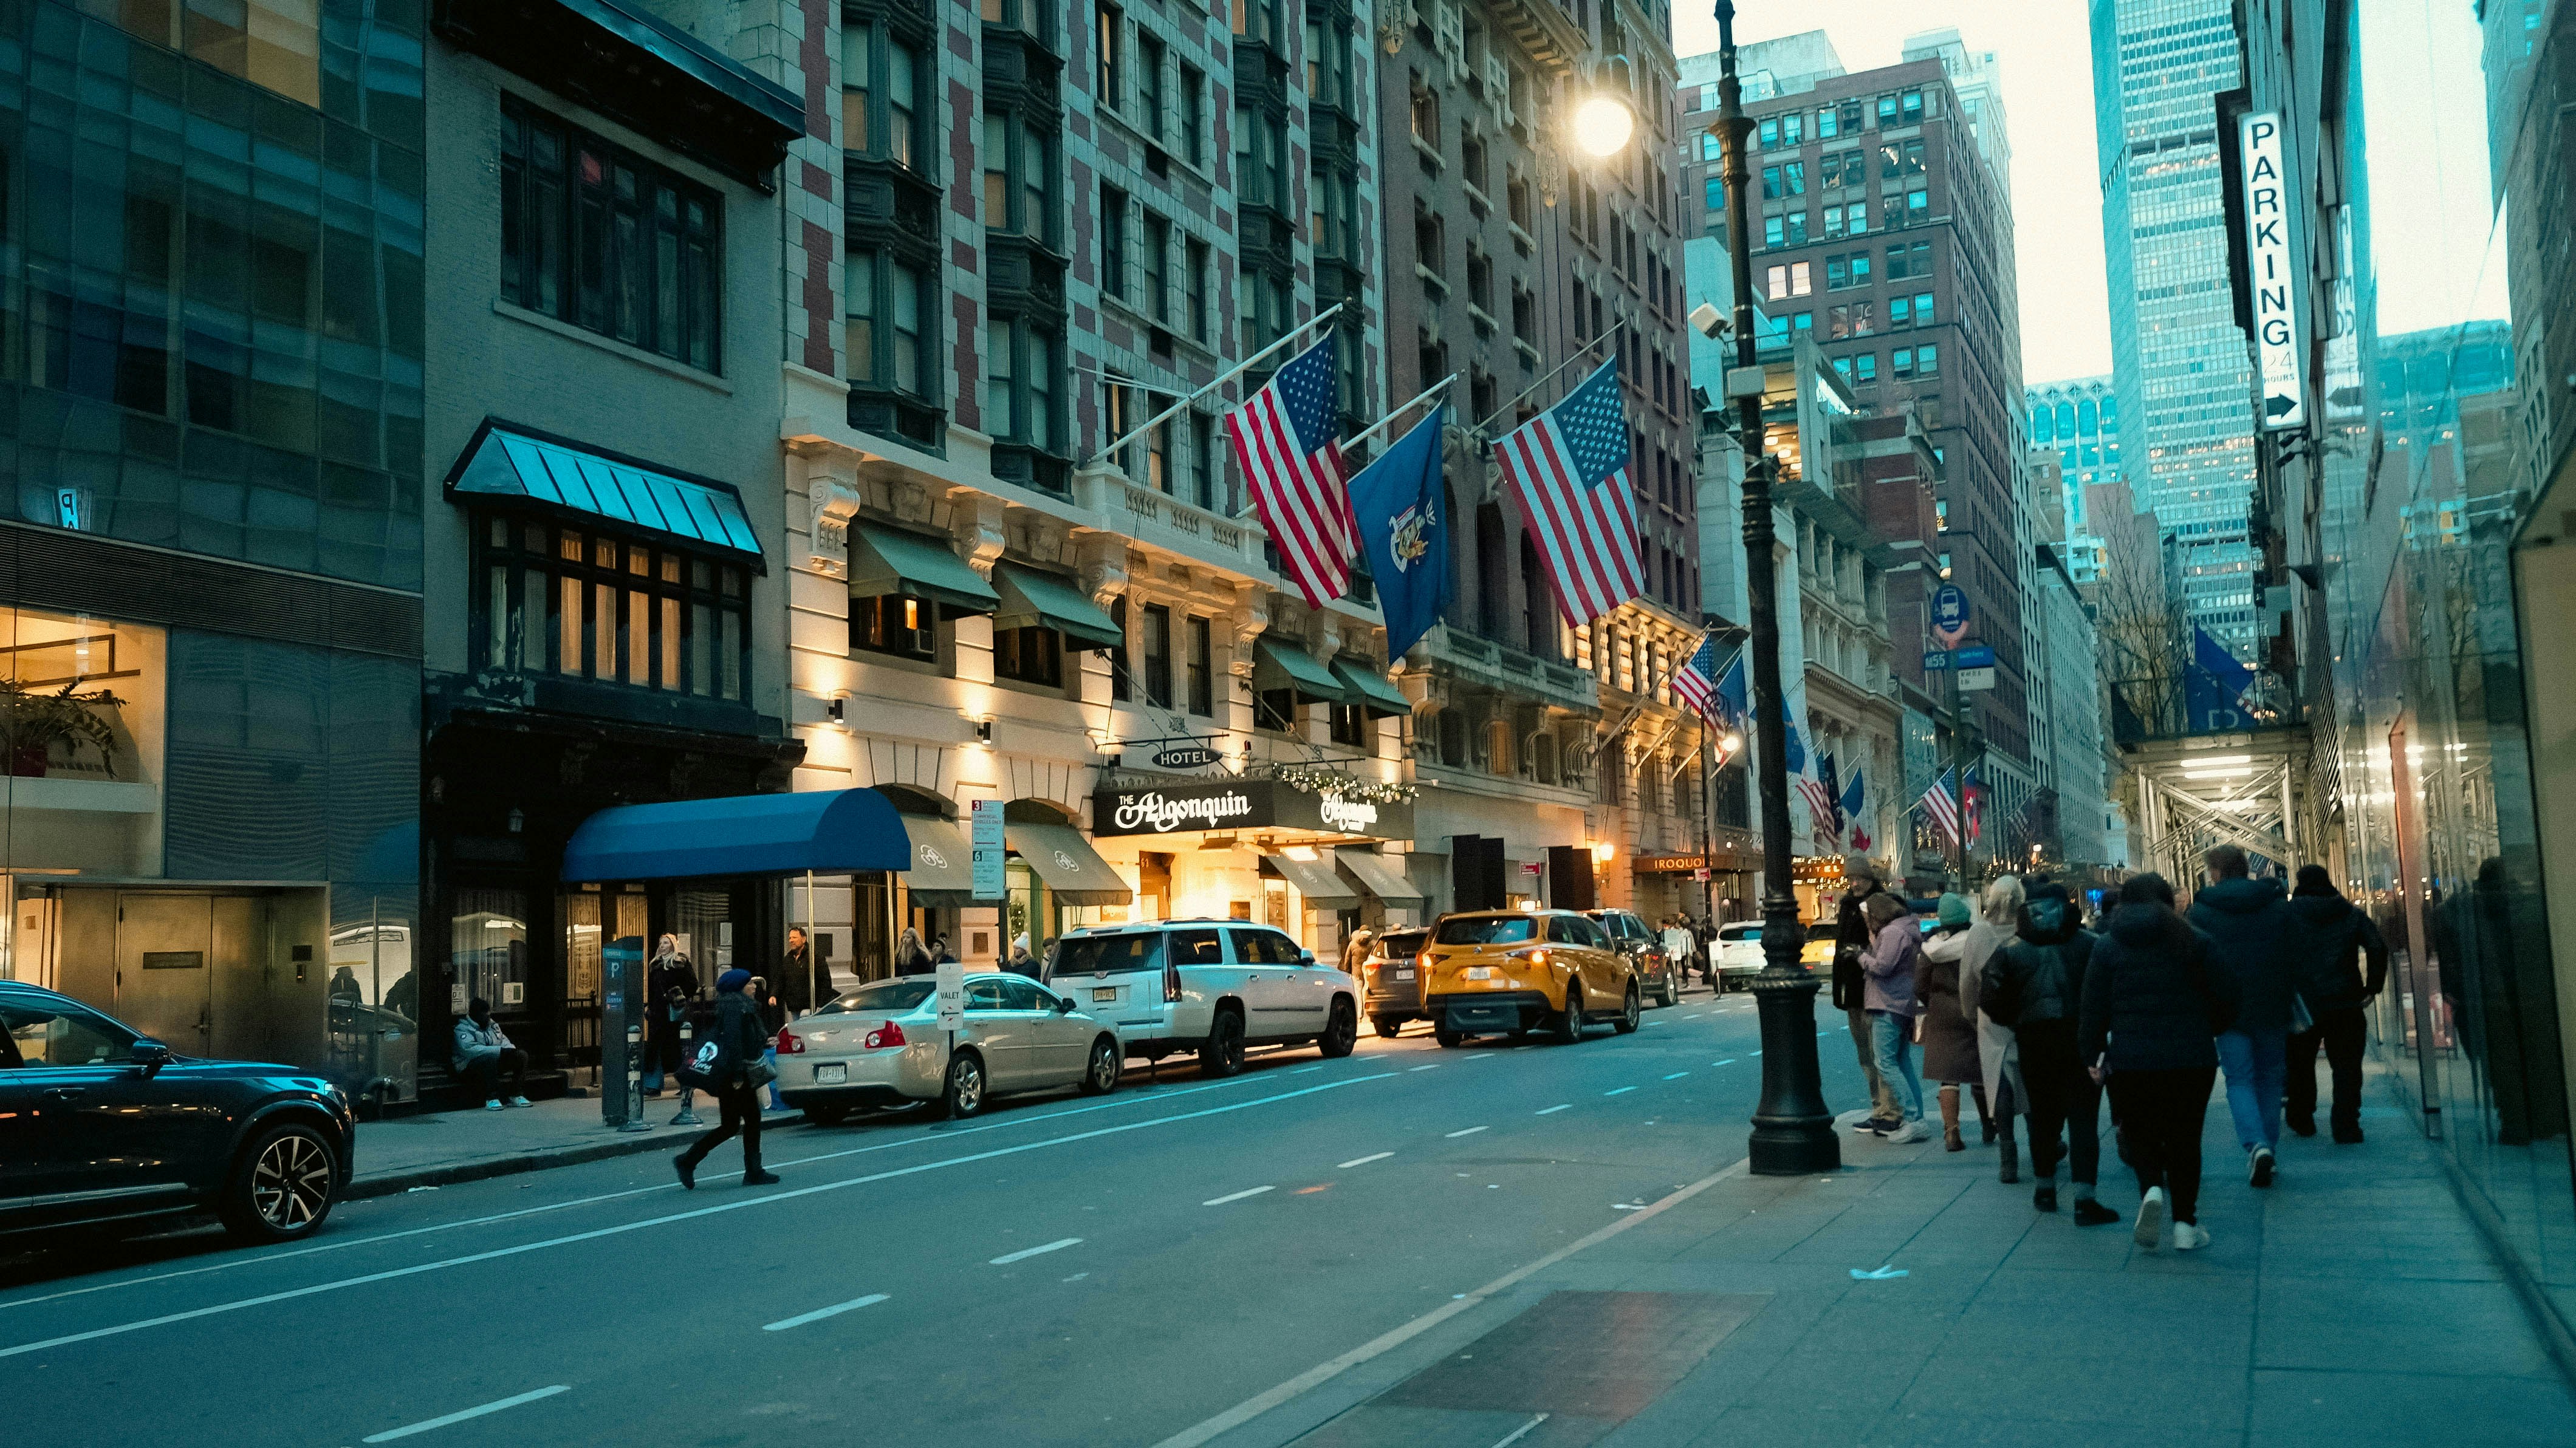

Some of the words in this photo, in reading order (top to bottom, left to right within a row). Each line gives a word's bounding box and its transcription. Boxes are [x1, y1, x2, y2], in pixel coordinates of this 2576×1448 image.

[2252, 123, 2290, 346] PARKING
[2264, 351, 2292, 373] 24
[2264, 374, 2295, 384] HOURS
[1161, 751, 1211, 765] HOTEL
[974, 801, 980, 810] 3
[1118, 795, 1134, 805] THE
[1115, 790, 1252, 832] Algonquin
[975, 851, 981, 861] 6
